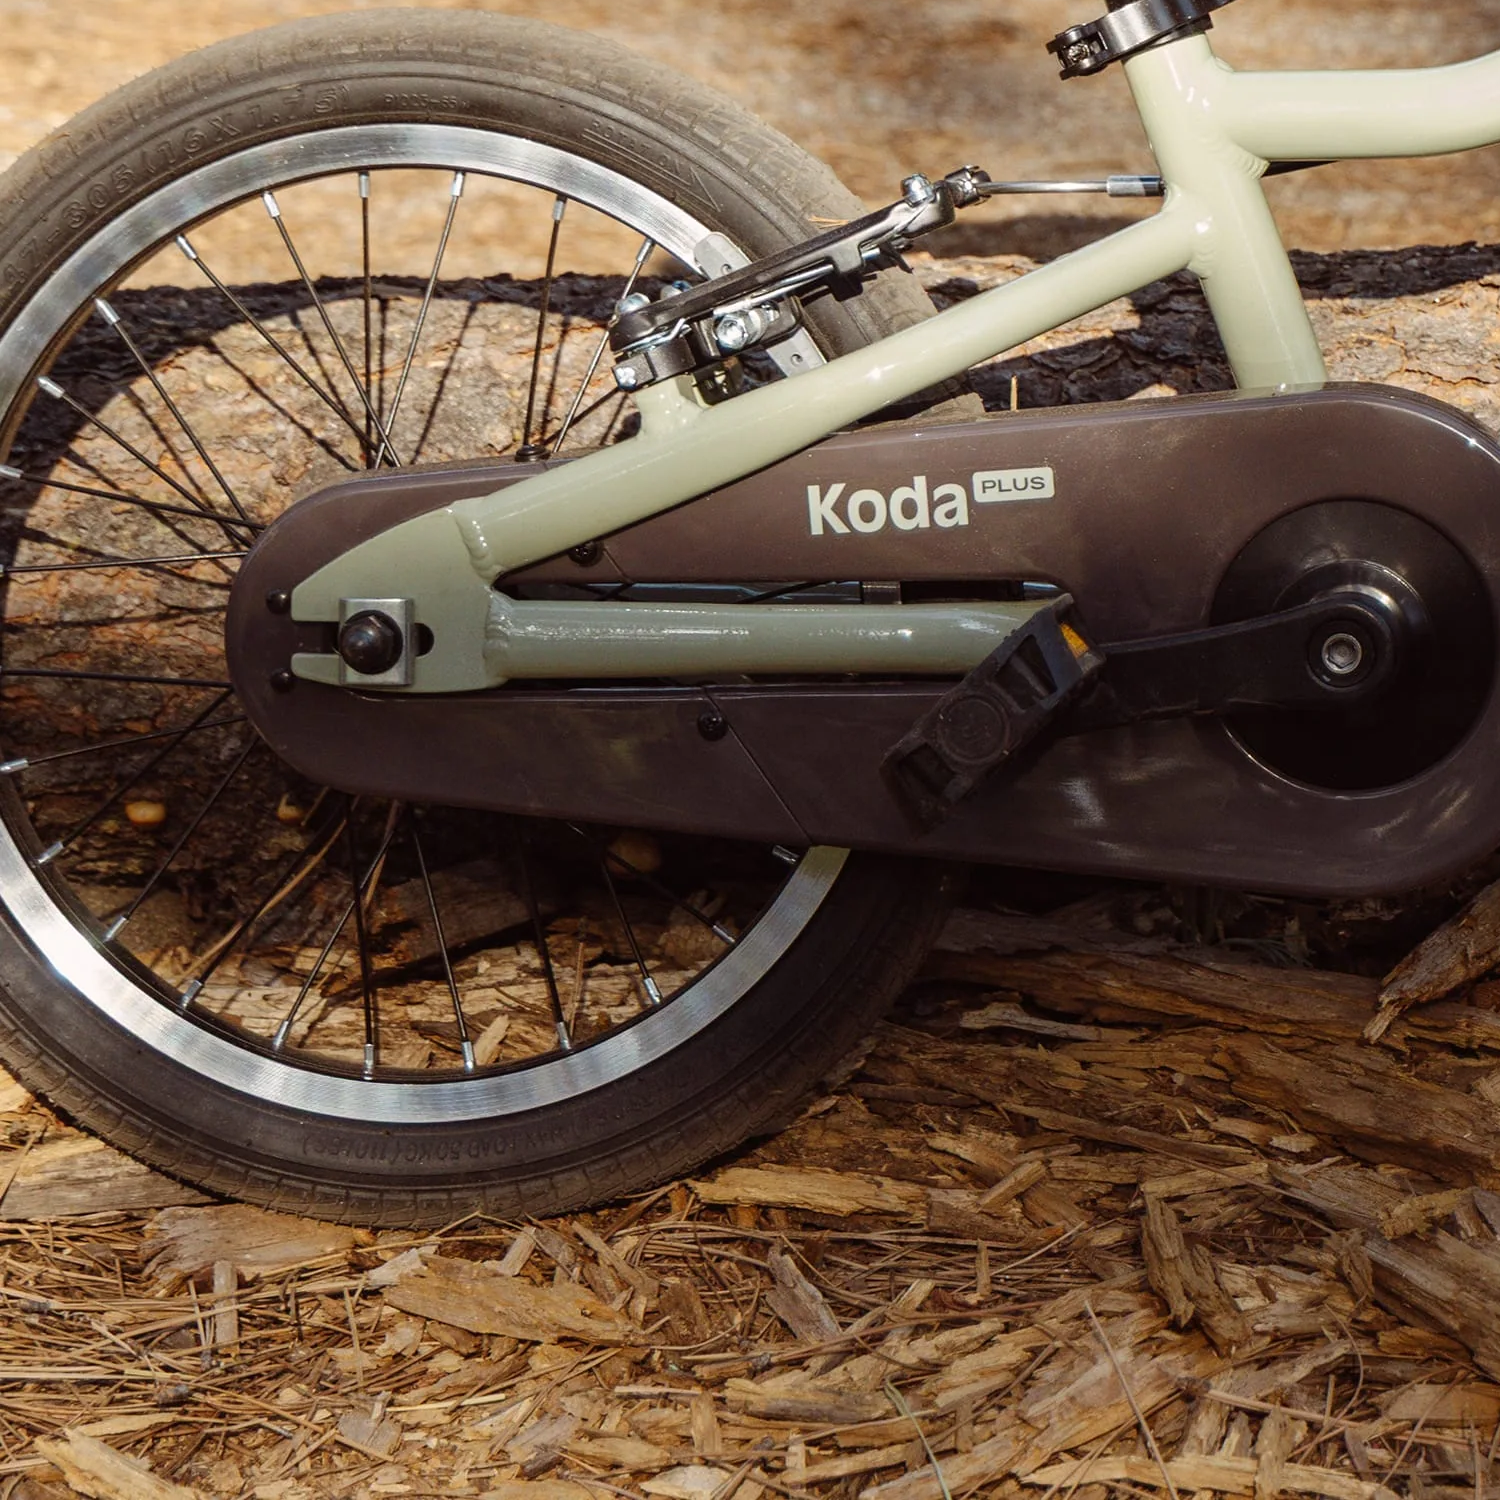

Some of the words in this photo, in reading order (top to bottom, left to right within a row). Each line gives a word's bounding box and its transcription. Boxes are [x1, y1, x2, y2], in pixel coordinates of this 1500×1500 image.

[591, 118, 683, 175] ROTATON
[806, 475, 969, 536] Koda
[981, 476, 1046, 494] PLUS
